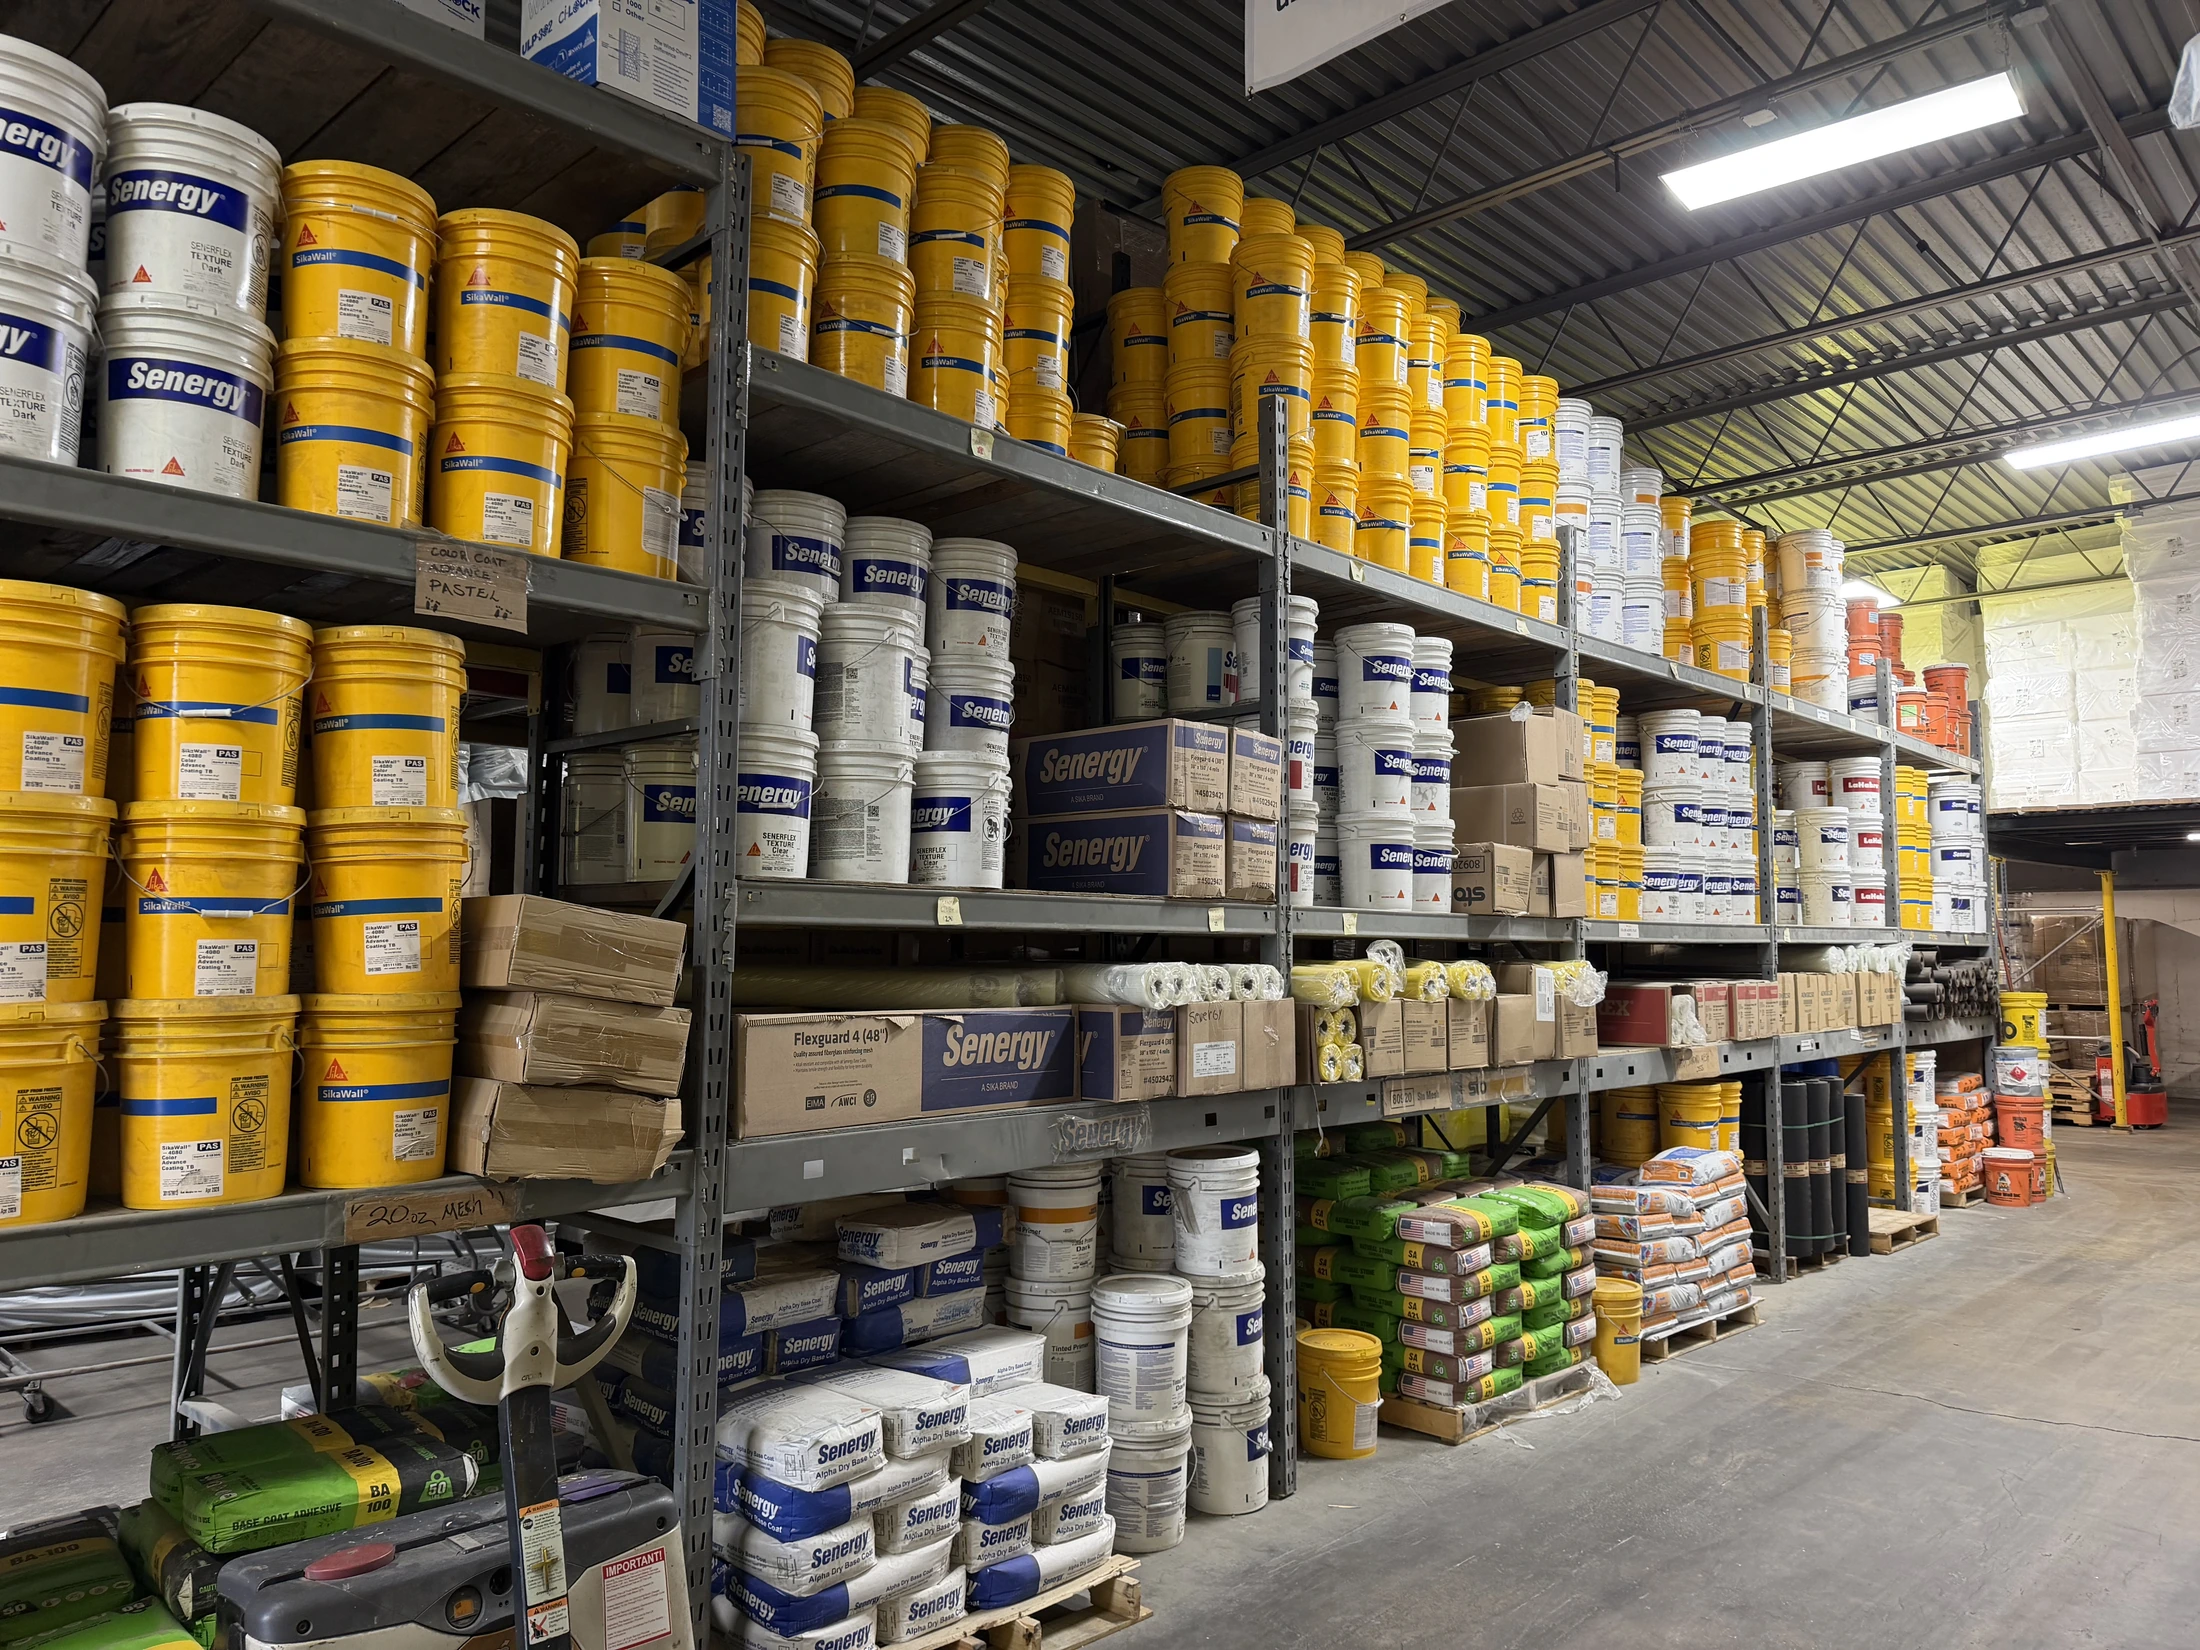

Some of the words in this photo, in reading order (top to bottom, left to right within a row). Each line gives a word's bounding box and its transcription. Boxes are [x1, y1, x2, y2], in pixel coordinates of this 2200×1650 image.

[626, 8, 645, 22] Other
[111, 177, 220, 214] Senergy
[190, 241, 232, 258] SENERFLEX
[190, 251, 232, 268] TEXTURE
[127, 360, 247, 412] Senergy
[12, 408, 36, 421] Dark
[515, 500, 532, 510] PAS
[431, 547, 467, 562] COLOR
[474, 553, 506, 567] COAT
[864, 565, 925, 593] Senergy
[429, 579, 500, 603] PASTEL
[957, 585, 1012, 613] Senergy
[65, 738, 83, 746] PAS
[1195, 732, 1224, 749] Senergy
[218, 750, 237, 758] PAS
[1253, 742, 1279, 761] Senergy
[1289, 740, 1314, 760] nergy
[738, 784, 802, 811] energy
[911, 804, 954, 825] nergy
[1198, 820, 1223, 835] Senergy
[1252, 826, 1276, 842] Senergy
[762, 832, 797, 842] SENERFLEX
[766, 840, 795, 848] TEXTURE
[771, 846, 789, 855] Clear
[916, 846, 947, 854] SENERFLEX
[1290, 843, 1314, 861] ergy
[398, 923, 416, 931] PAS
[22, 944, 43, 953] PAS
[235, 944, 254, 953] PAS
[1144, 1016, 1172, 1030] Senergy
[794, 1029, 850, 1048] Flexguard
[852, 1030, 860, 1043] 4
[863, 1027, 888, 1045] (48")
[326, 1064, 344, 1080] Sika
[987, 1082, 999, 1092] SIKA
[999, 1081, 1019, 1091] BRAND
[28, 1093, 61, 1102] WARNING
[838, 1096, 857, 1107] AWCI
[32, 1102, 53, 1110] AVISO
[1063, 1114, 1142, 1150] Senergy
[199, 1142, 219, 1150] PAS
[768, 1206, 801, 1224] Senergy
[1314, 1209, 1325, 1218] SA
[1314, 1217, 1325, 1227] 421
[838, 1227, 881, 1246] Senergy
[920, 1240, 940, 1250] Senergy
[1076, 1243, 1091, 1252] Dark
[1407, 1250, 1418, 1259] SA
[936, 1259, 980, 1276] Senergy
[1407, 1258, 1420, 1268] 421
[1434, 1262, 1444, 1271] 50
[863, 1273, 908, 1298] Senergy
[932, 1278, 947, 1286] Alpha
[948, 1277, 956, 1286] Dry
[863, 1301, 878, 1311] Alpha
[878, 1298, 887, 1308] Dry
[887, 1294, 899, 1303] Base
[898, 1290, 910, 1299] Coat
[751, 1312, 774, 1325] Senergy
[784, 1330, 836, 1354] Senergy
[1072, 1342, 1089, 1351] Primer
[1408, 1353, 1418, 1362] SA
[1407, 1361, 1420, 1371] 421
[1434, 1366, 1444, 1375] 50
[916, 1405, 967, 1431] Senergy
[1063, 1413, 1107, 1436] Senergy
[818, 1427, 877, 1465] Senergy
[984, 1428, 1031, 1456] Senergy
[815, 1465, 837, 1480] Alpha
[838, 1461, 851, 1475] Dry
[852, 1456, 868, 1469] Base
[869, 1447, 883, 1464] Coat
[371, 1483, 390, 1498] BA
[427, 1481, 446, 1495] 50
[367, 1498, 391, 1513] 100
[732, 1480, 780, 1520] Senergy
[232, 1518, 260, 1533] BASE
[263, 1512, 290, 1528] COAT
[293, 1502, 342, 1521] ADHESIVE
[907, 1496, 959, 1528] Senergy
[1059, 1497, 1104, 1522] Senergy
[980, 1519, 1029, 1549] Senergy
[812, 1528, 870, 1569] Senergy
[605, 1549, 663, 1577] IMPORTANT!
[729, 1577, 776, 1620] Senergy
[910, 1584, 964, 1620] Senergy
[815, 1621, 873, 1650] Senergy
